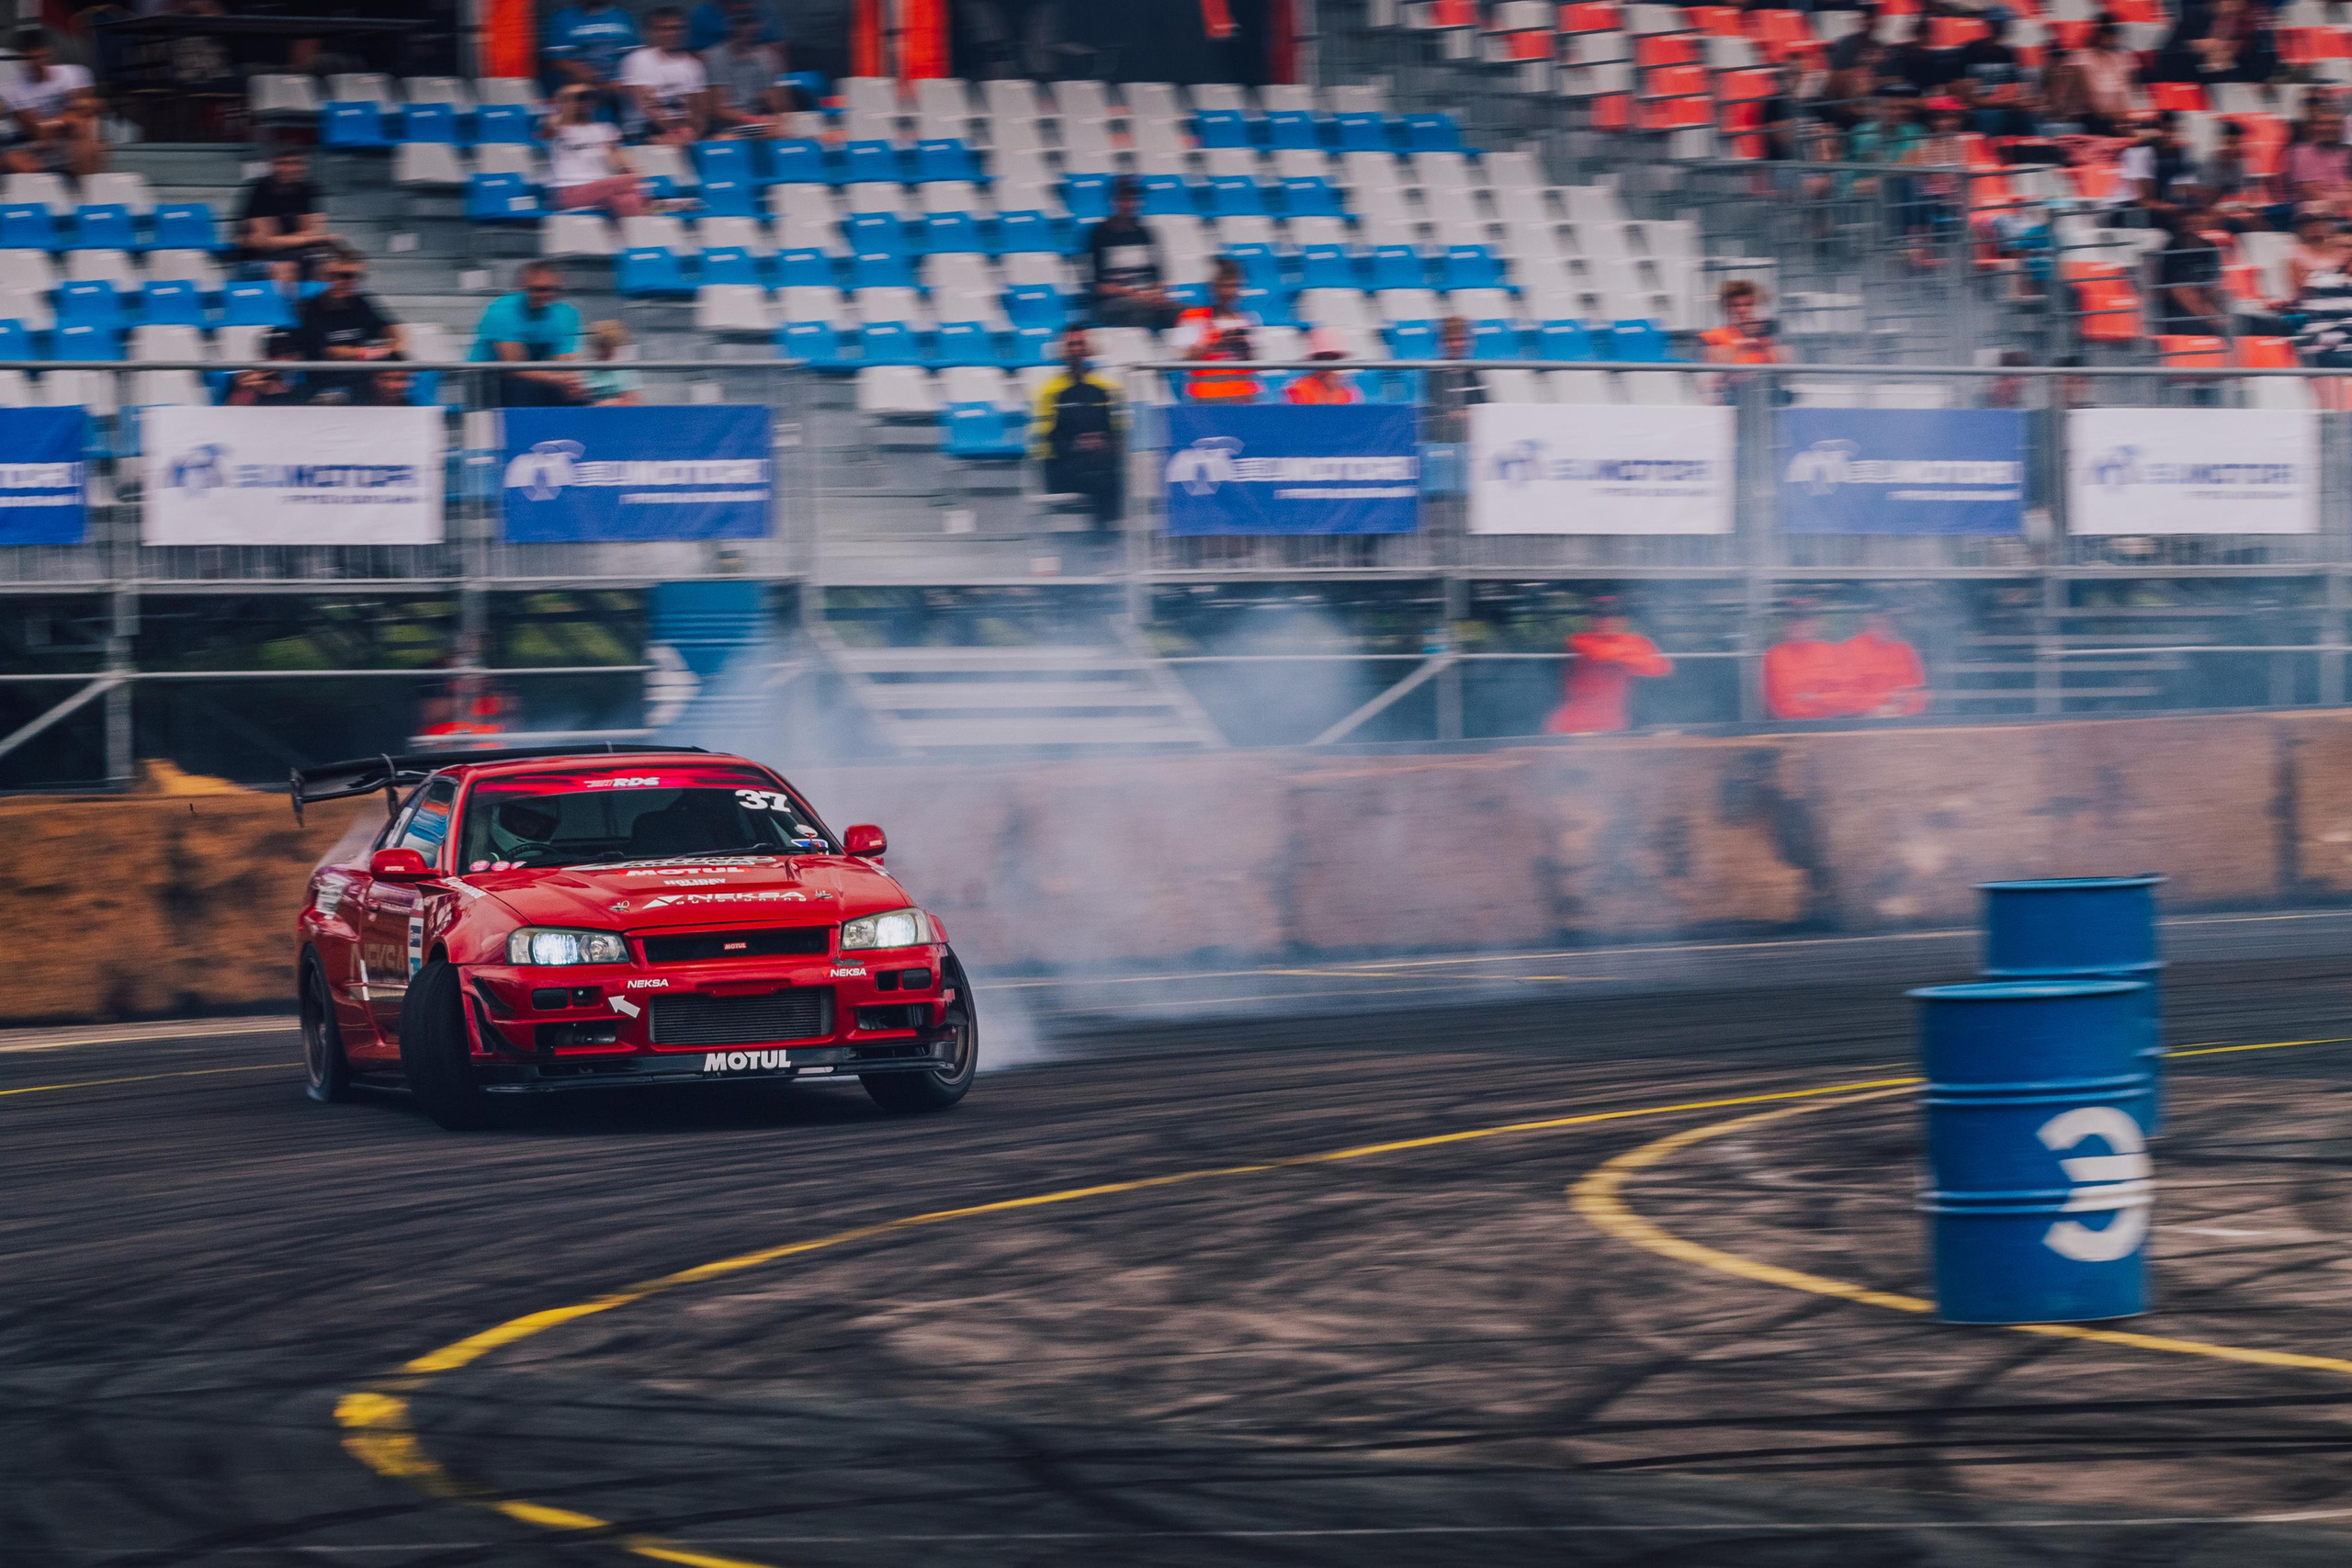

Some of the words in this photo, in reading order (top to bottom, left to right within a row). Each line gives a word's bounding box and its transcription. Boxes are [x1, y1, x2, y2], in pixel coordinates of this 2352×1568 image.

[613, 777, 660, 787] RDS
[735, 789, 791, 813] 37
[626, 866, 745, 877] MOTUL
[687, 891, 807, 901] NEKSA
[830, 968, 866, 977] NEKSA
[627, 978, 669, 988] NEKSA
[703, 1049, 791, 1072] MOTUL
[2036, 1106, 2154, 1262] 3
